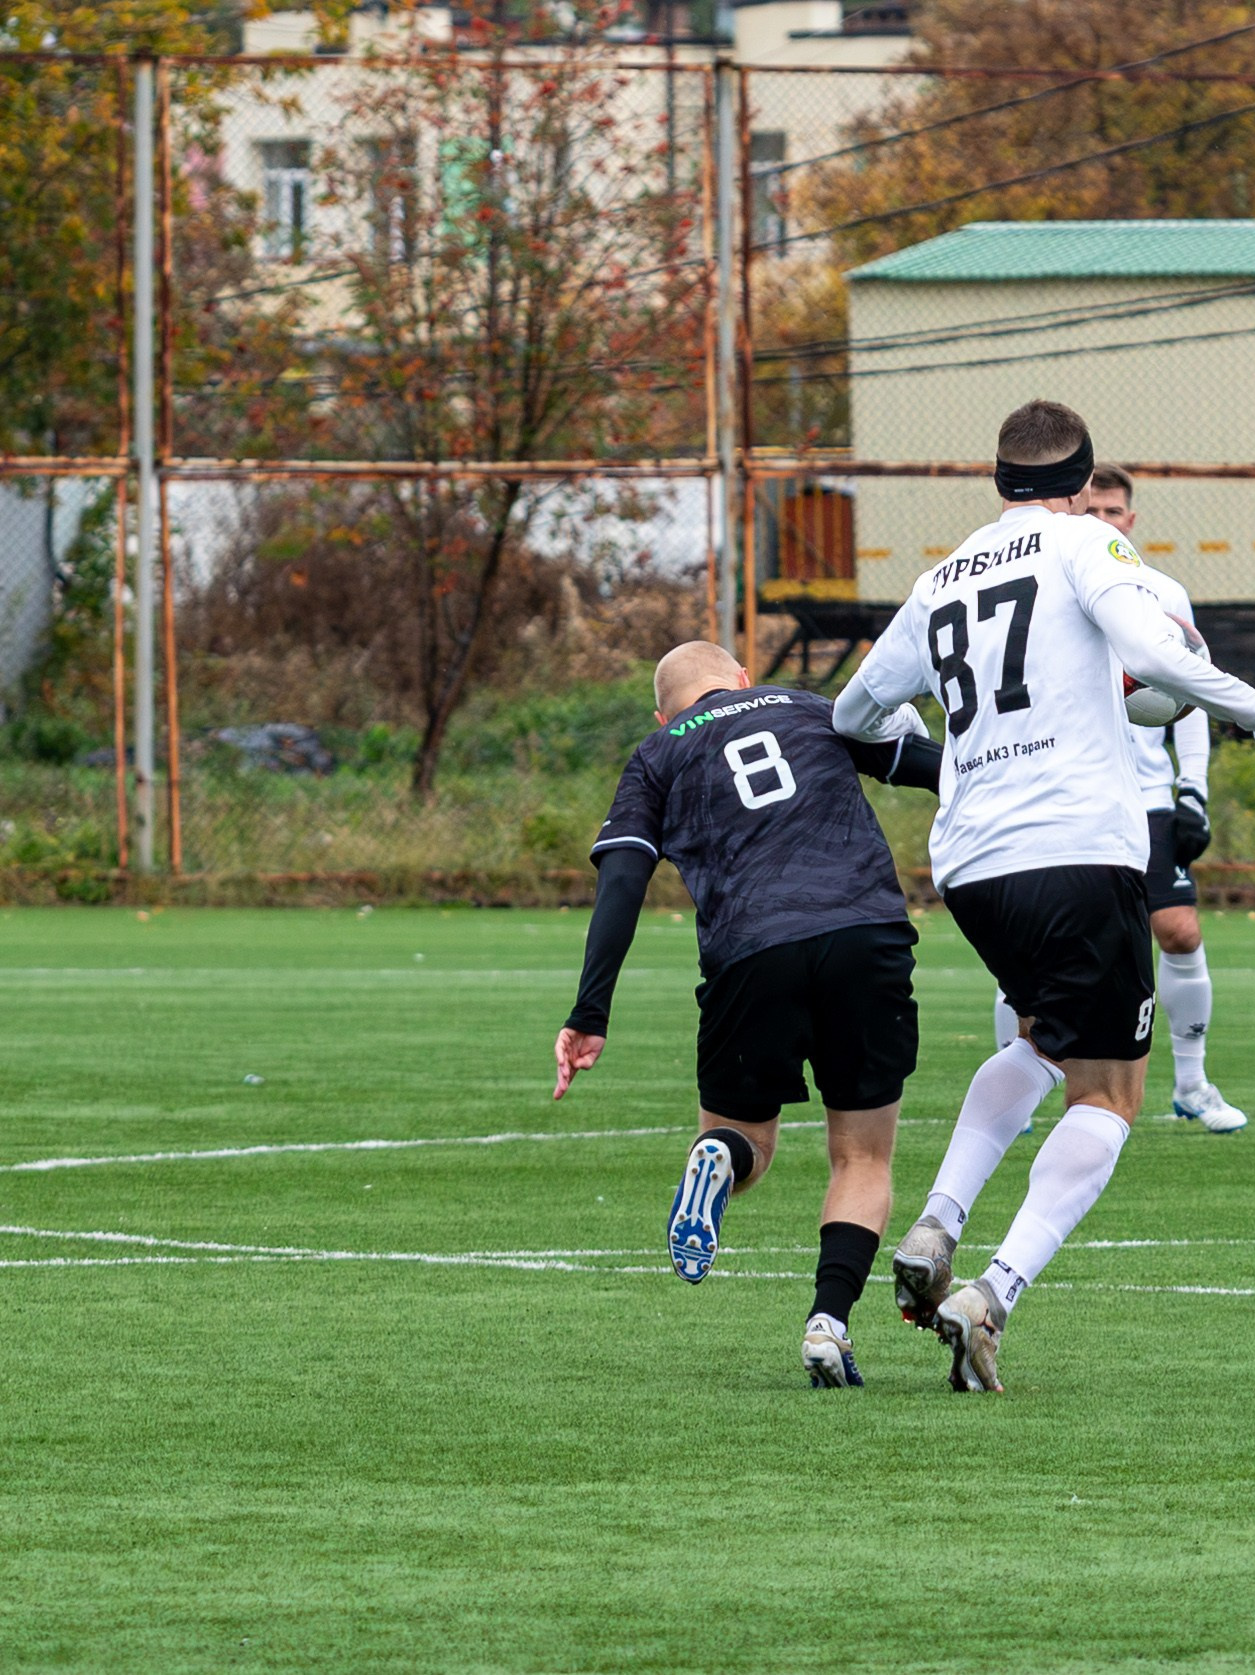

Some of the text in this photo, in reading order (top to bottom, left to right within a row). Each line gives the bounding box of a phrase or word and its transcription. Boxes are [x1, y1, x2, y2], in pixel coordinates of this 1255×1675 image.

[931, 531, 1042, 596] ТУРБИНА
[928, 574, 1039, 740] 87
[669, 695, 793, 737] VINSERVICE
[723, 730, 797, 810] 8
[1013, 737, 1055, 757] Гарант
[1134, 991, 1156, 1041] 8
